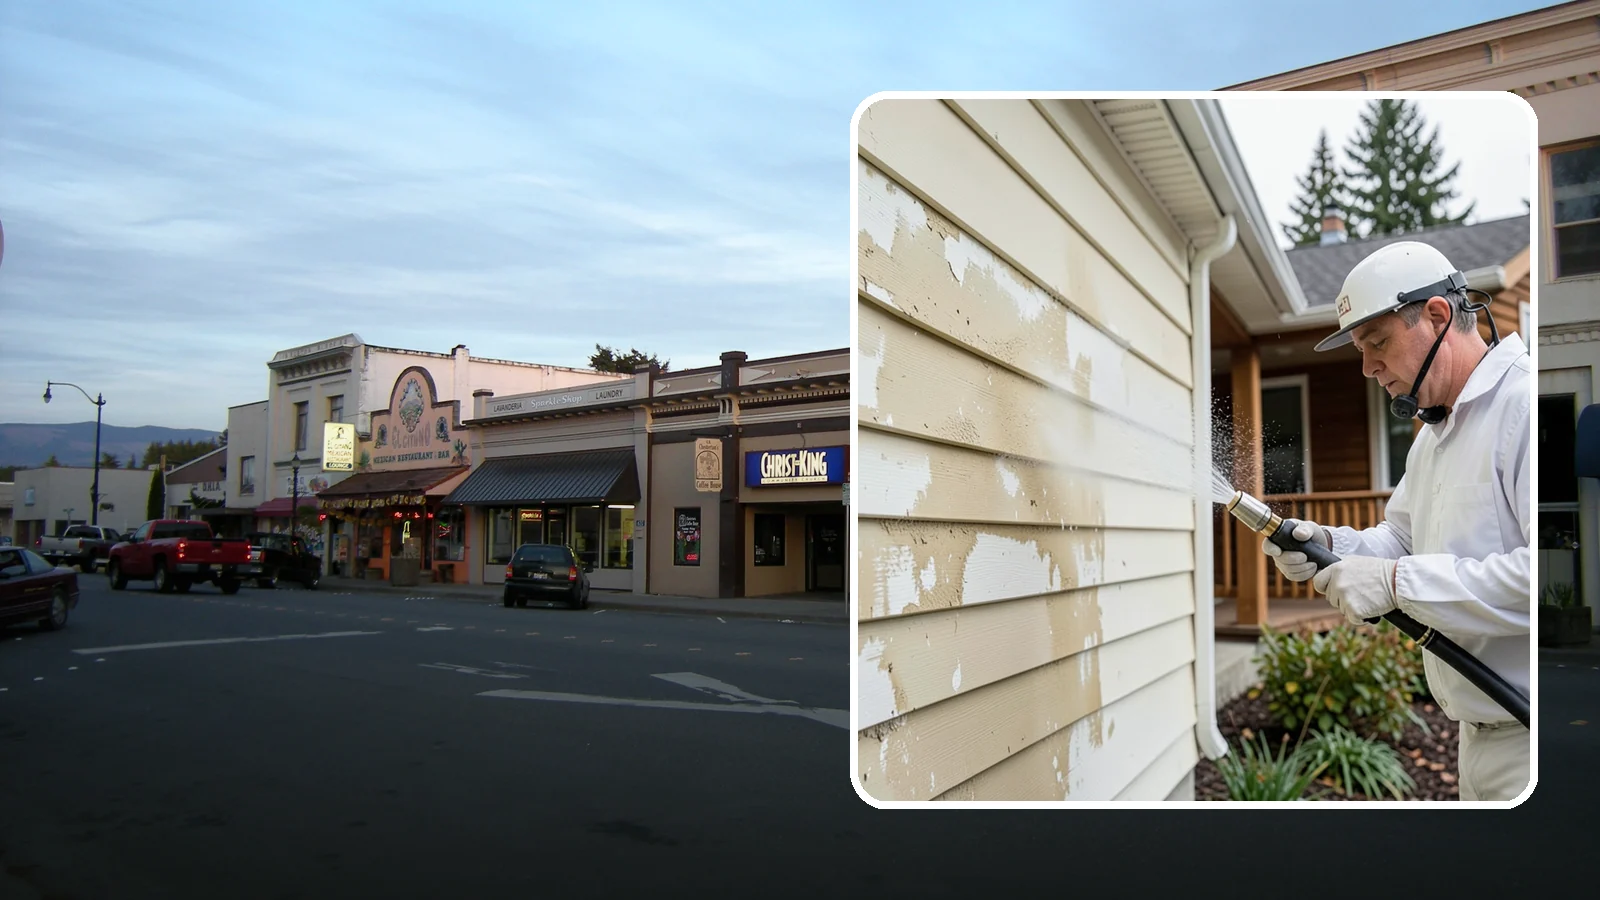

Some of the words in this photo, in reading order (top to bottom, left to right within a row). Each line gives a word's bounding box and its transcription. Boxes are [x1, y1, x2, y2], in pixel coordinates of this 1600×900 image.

[595, 389, 624, 400] LAUNDRY
[493, 402, 523, 413] LAVANDERIA
[531, 397, 561, 409] Sparkle
[562, 394, 583, 405] Shop
[374, 454, 396, 464] MEXICAN
[397, 451, 433, 463] RESTAURANT
[438, 450, 450, 459] BAR
[760, 452, 797, 478] CHRIST
[798, 450, 827, 476] KING
[696, 480, 709, 489] Coffee
